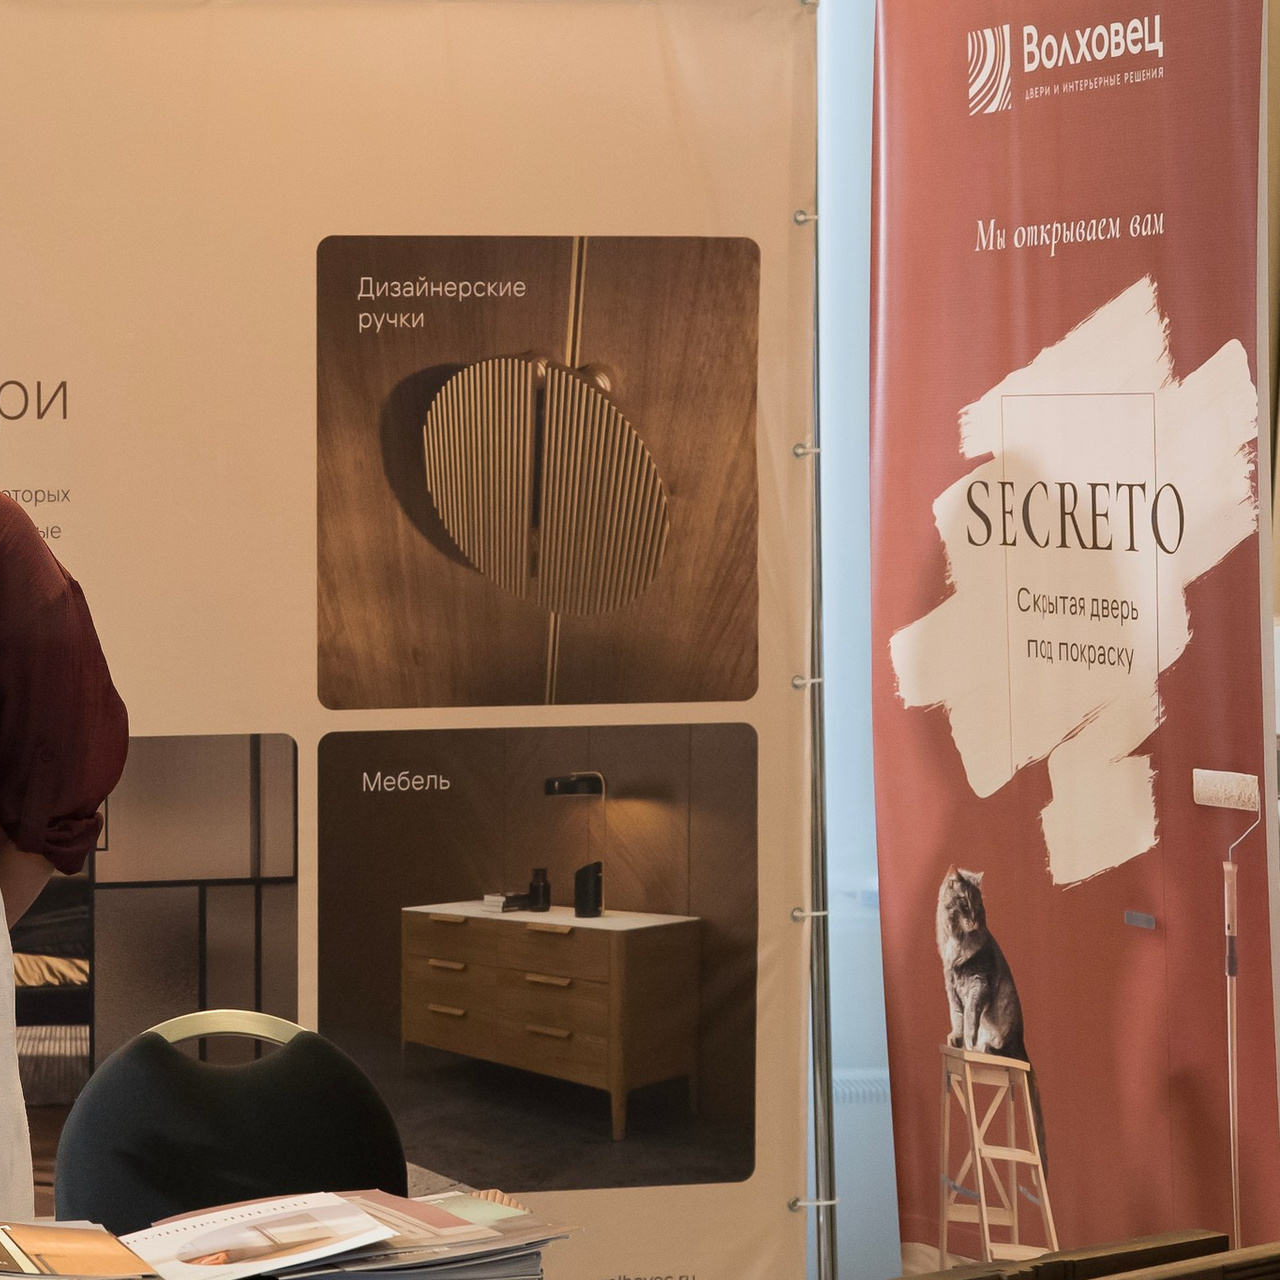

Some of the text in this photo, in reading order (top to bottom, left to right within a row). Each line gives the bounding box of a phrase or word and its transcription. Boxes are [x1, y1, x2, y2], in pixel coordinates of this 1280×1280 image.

[1022, 14, 1164, 73] Волховец
[1024, 66, 1164, 101] ДВЕРИ И ИНТЕРЬЕРНЫЕ РЕШЕНИЯ
[974, 212, 1165, 257] Мы открываем вам
[357, 276, 527, 302] Дизайнерские
[358, 310, 425, 333] ручки
[966, 480, 1185, 554] SECRETO
[1017, 587, 1139, 626] Скрытая дверь
[1027, 639, 1135, 674] под покраску
[362, 770, 451, 792] Мебель
